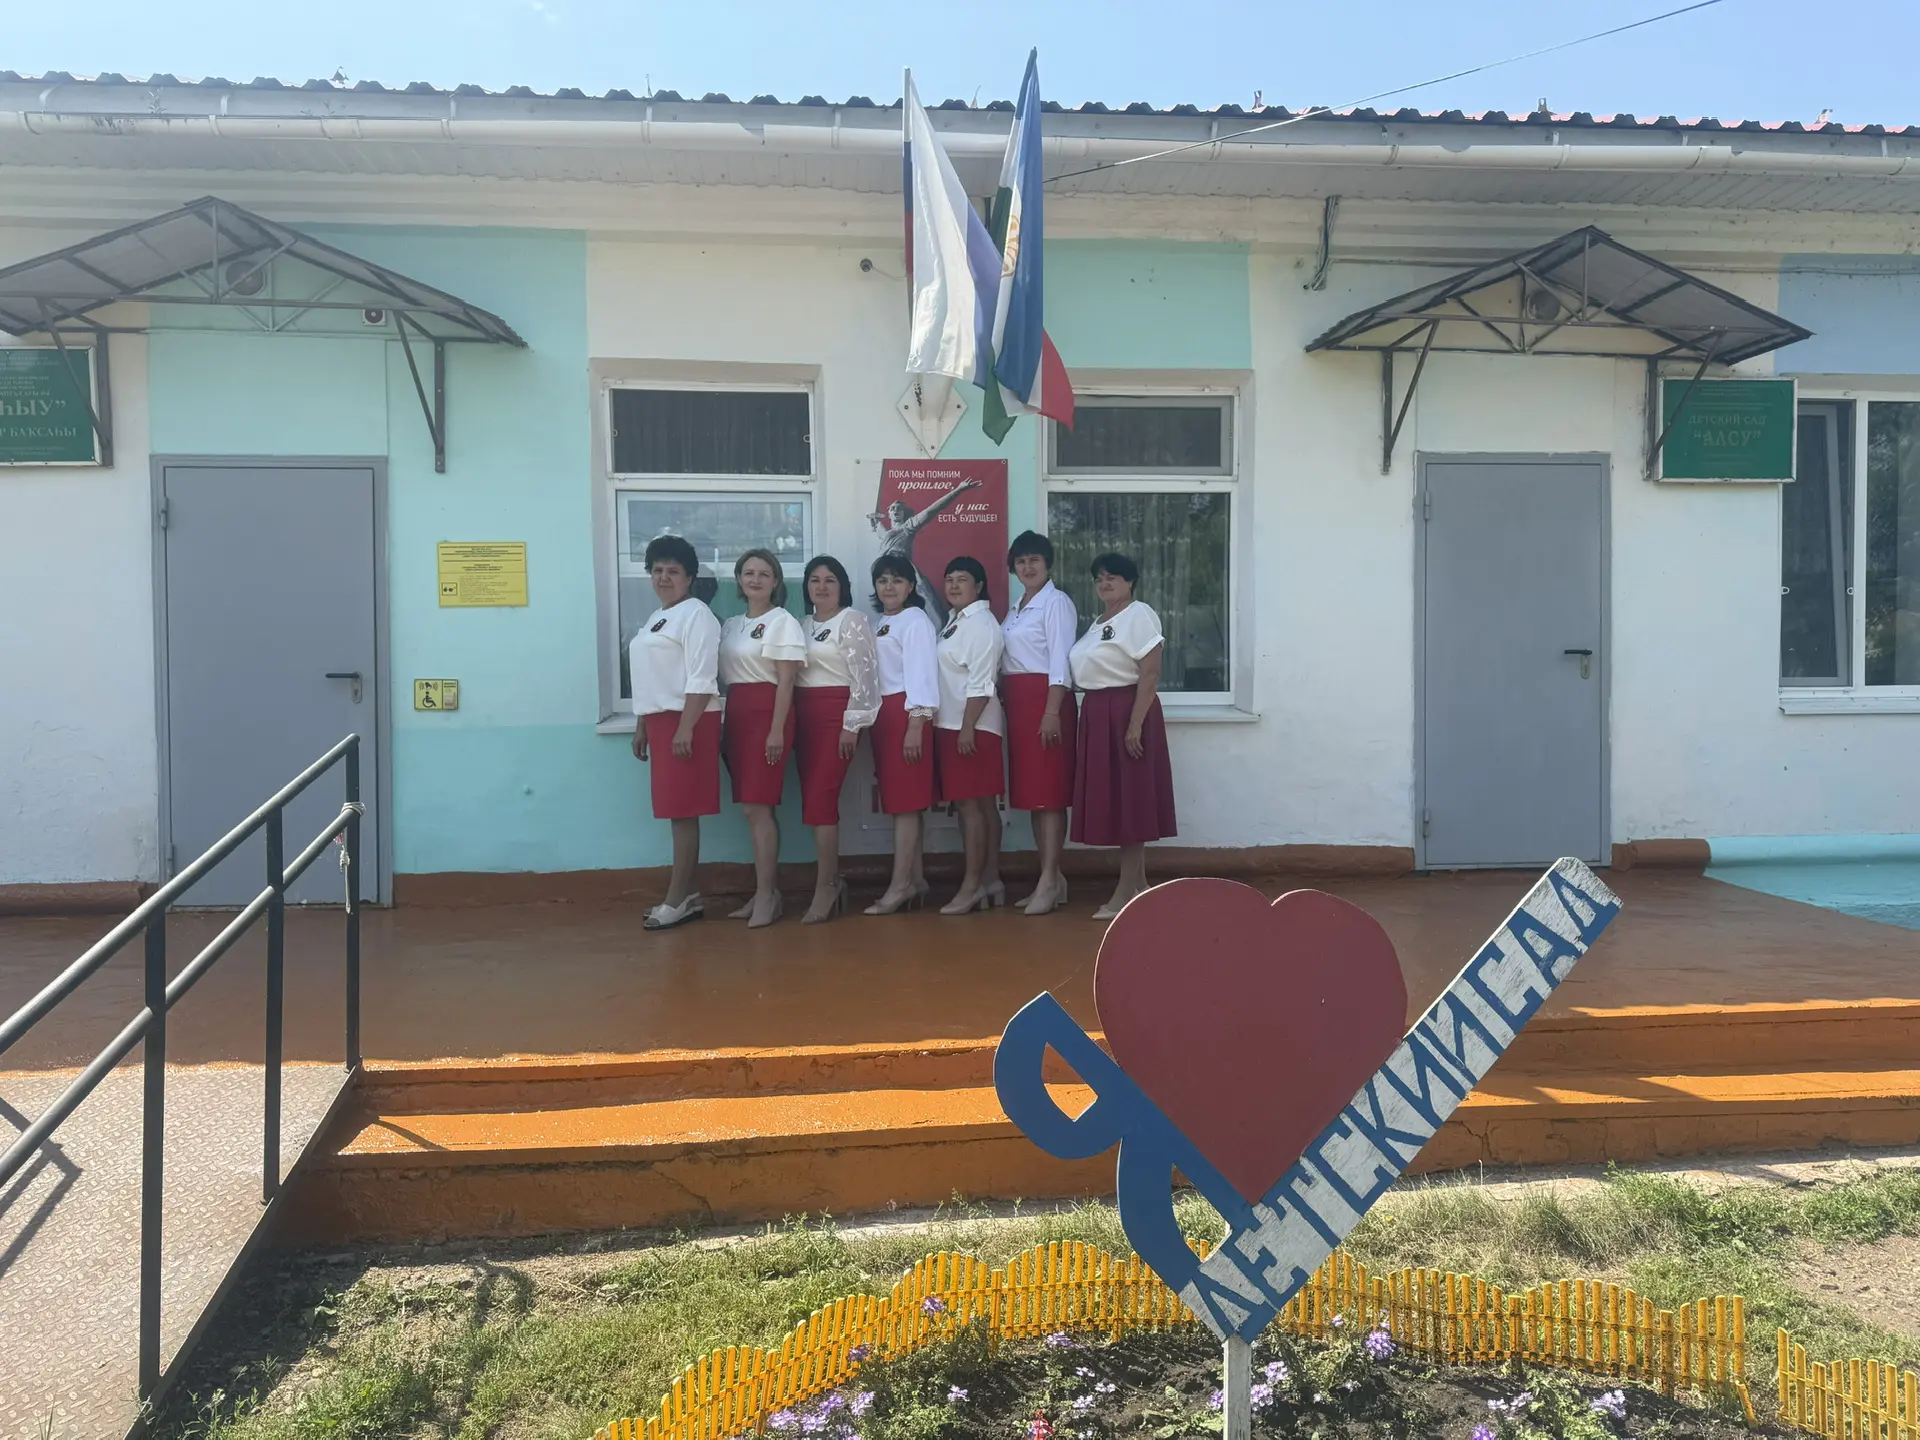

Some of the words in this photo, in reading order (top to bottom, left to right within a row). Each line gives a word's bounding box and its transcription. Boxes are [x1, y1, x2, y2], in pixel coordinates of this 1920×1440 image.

[1688, 414, 1740, 425] ДЕТСКИЙ
[1743, 415, 1767, 425] САД
[889, 470, 910, 478] ПОКА
[898, 481, 955, 492] прошлое,
[955, 504, 964, 514] у
[938, 514, 956, 522] ЕСТЬ
[960, 514, 997, 522] БУДУЩЕЕ!
